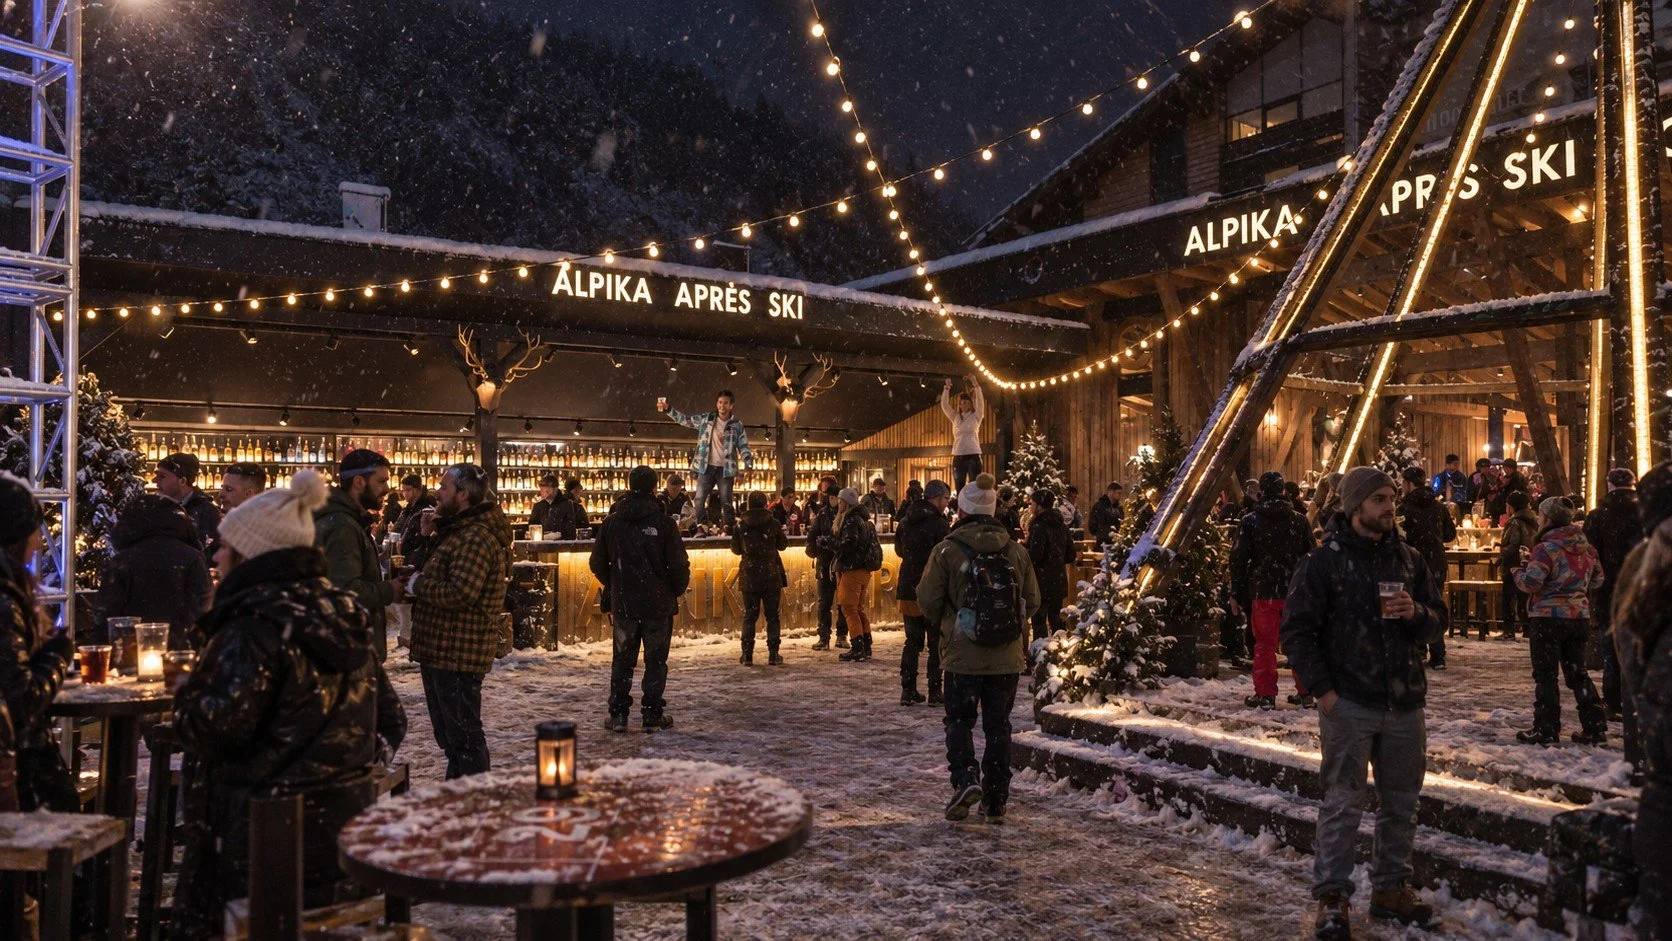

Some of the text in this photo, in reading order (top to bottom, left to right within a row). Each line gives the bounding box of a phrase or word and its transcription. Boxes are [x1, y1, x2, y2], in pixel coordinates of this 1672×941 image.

[1183, 139, 1576, 257] ALPIKA PRS SKI
[551, 269, 804, 320] ALPIKA APRÈS SKI
